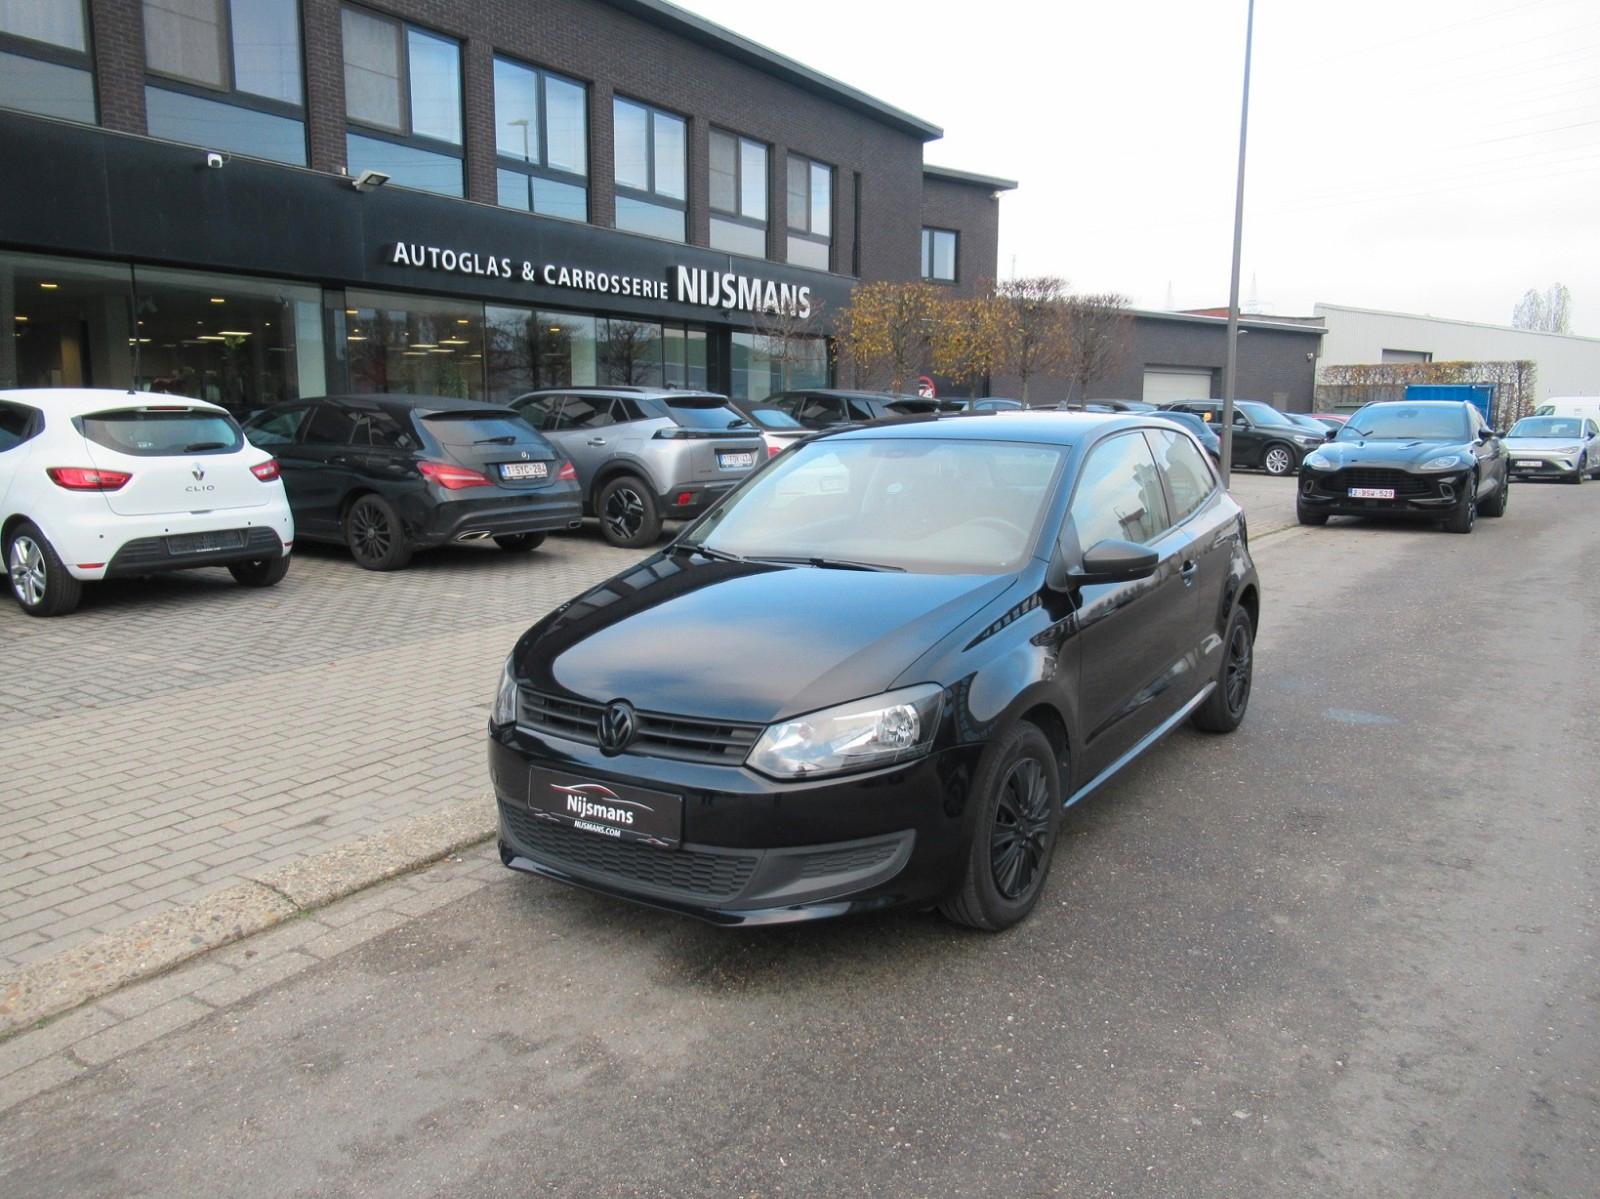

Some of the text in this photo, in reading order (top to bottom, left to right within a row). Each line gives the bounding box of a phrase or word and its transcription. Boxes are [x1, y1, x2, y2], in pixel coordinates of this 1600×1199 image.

[392, 241, 812, 319] AUTOGLAS & CARROSSERIE NIJSMANS
[185, 484, 216, 493] CLIO
[567, 794, 634, 824] Nijsmans
[573, 820, 621, 838] NIJSMANS.COM
